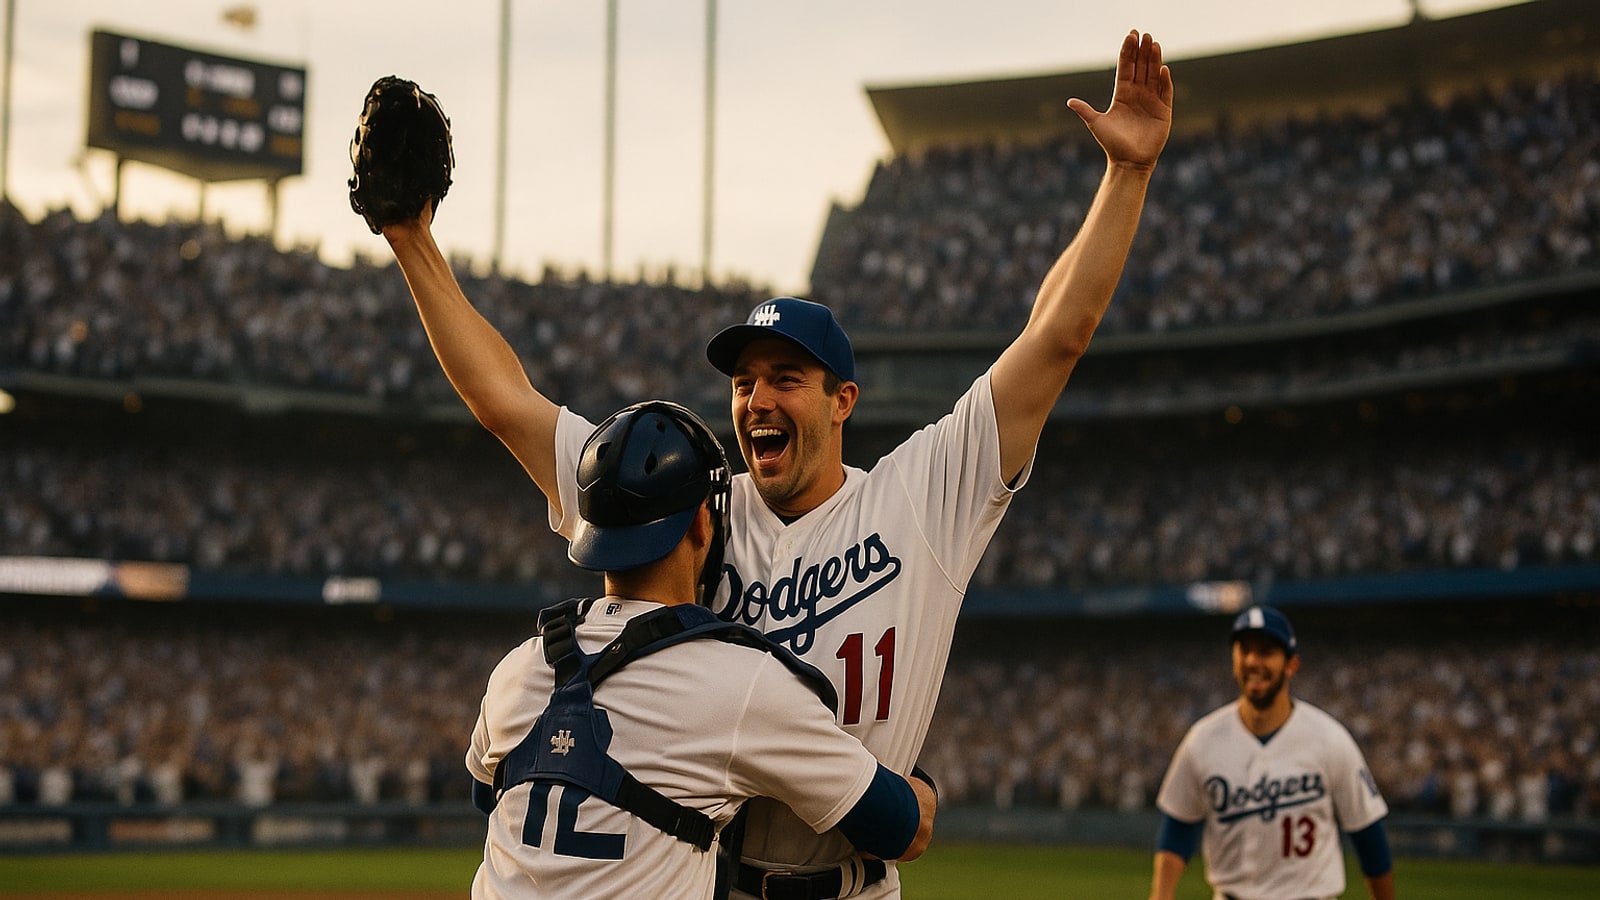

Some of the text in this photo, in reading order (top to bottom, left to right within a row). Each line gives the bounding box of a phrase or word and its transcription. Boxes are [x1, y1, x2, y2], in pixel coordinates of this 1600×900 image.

[713, 532, 902, 656] Dodgers
[835, 626, 896, 726] 11
[1203, 773, 1327, 823] Dodgers
[1281, 815, 1316, 859] 13
